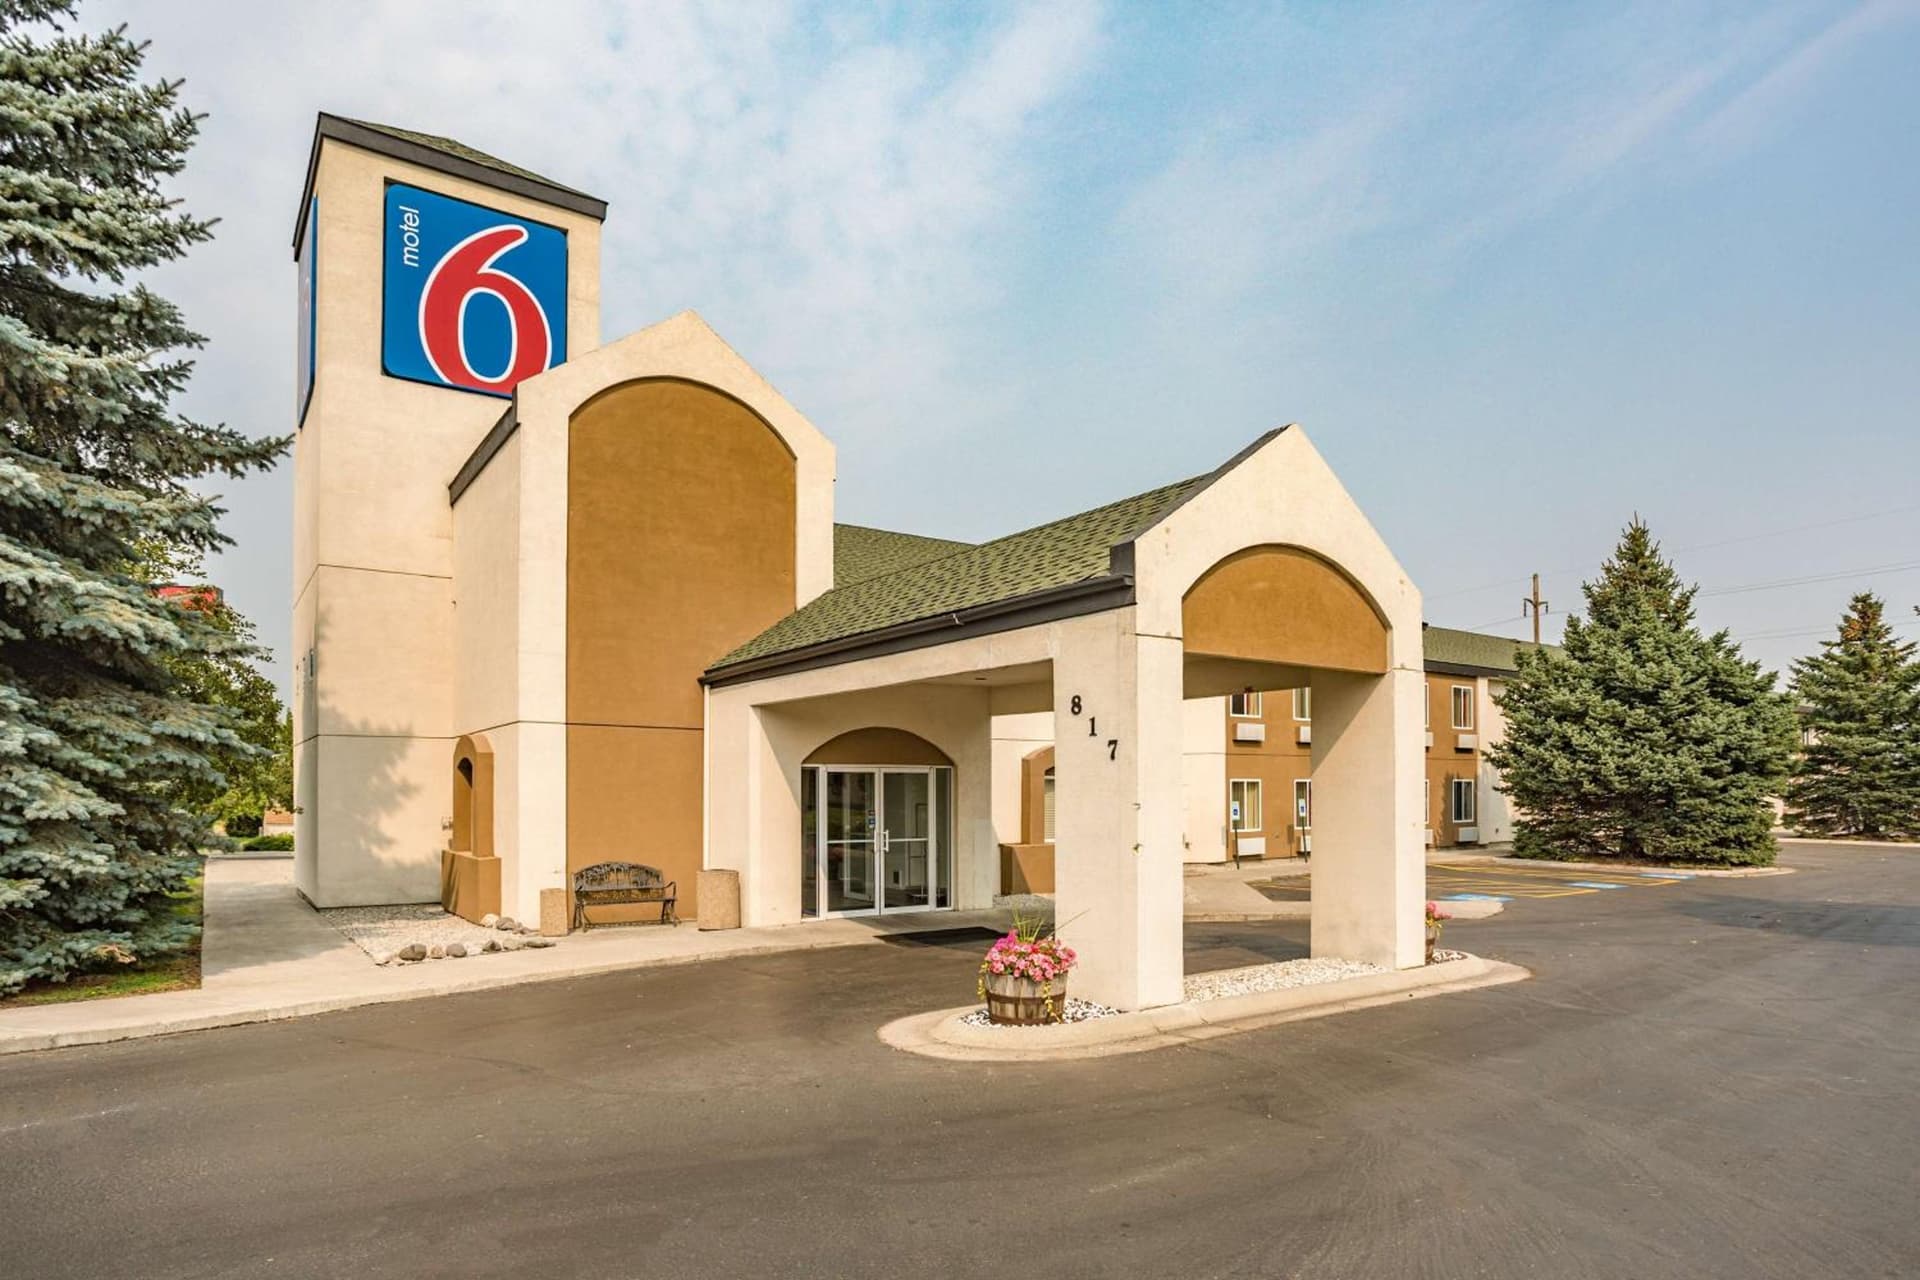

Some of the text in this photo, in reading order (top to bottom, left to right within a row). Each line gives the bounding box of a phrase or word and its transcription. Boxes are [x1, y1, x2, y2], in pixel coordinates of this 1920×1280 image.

[399, 205, 420, 267] motel
[418, 224, 552, 397] 6
[1071, 695, 1118, 761] 817
